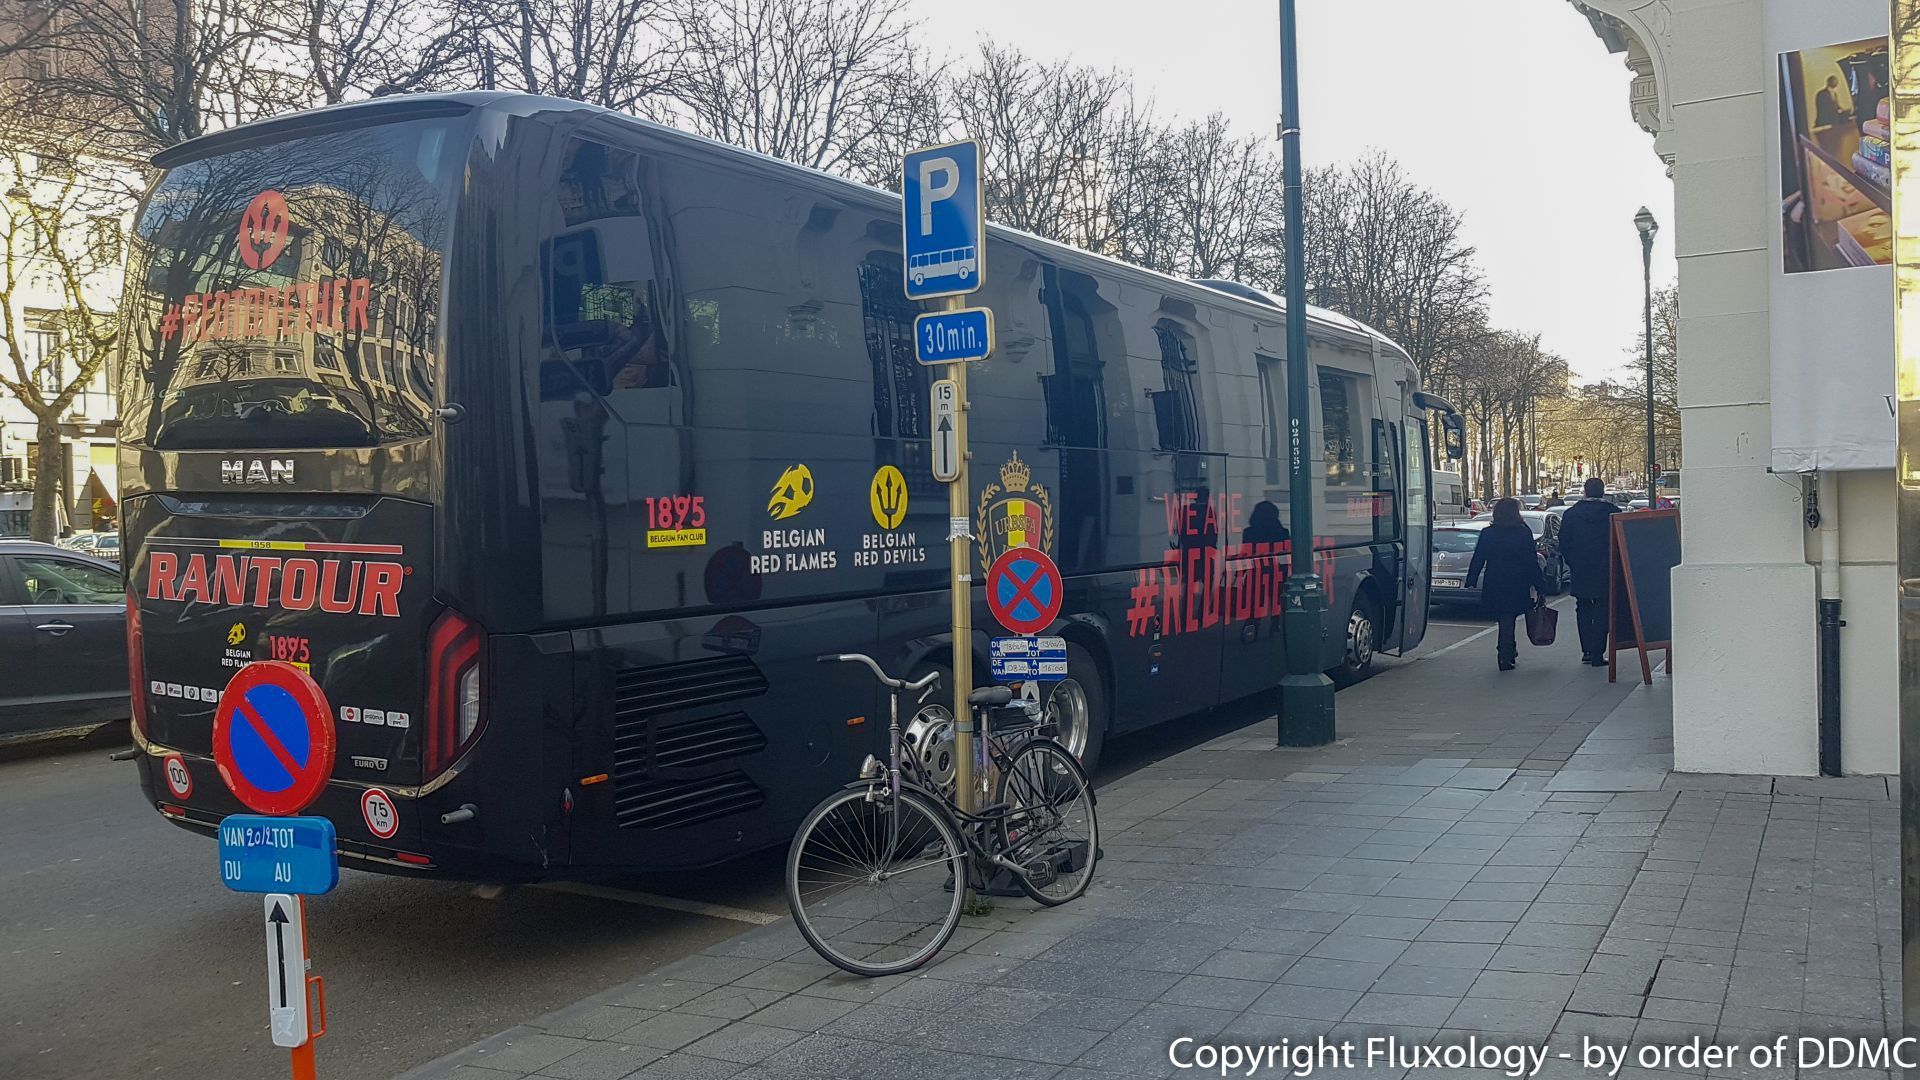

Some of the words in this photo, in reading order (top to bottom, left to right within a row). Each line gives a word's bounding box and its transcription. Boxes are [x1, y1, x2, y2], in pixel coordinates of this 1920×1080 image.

[919, 156, 960, 236] P
[160, 278, 370, 341] #REDTOGETHER
[938, 386, 951, 400] 15
[940, 403, 949, 411] m
[221, 459, 296, 484] MAN
[646, 494, 706, 533] 1895
[1164, 493, 1198, 535] WE
[1203, 493, 1243, 535] ARE
[251, 541, 271, 549] 1958
[650, 535, 676, 543] BELGIUM
[690, 533, 704, 541] CLUB
[763, 528, 825, 549] BELGIAN
[863, 532, 916, 549] BELGIAN
[751, 554, 781, 574] RED
[786, 551, 837, 572] FLAMES
[854, 551, 879, 567] RED
[883, 547, 926, 564] DEVILS
[147, 552, 404, 617] RANTOUR
[225, 648, 251, 658] BELGIAN
[269, 634, 310, 663] 1895
[221, 658, 233, 667] RED
[992, 668, 1007, 676] VAN
[354, 760, 375, 769] EURO
[169, 766, 188, 785] 100
[369, 801, 388, 818] 75
[375, 818, 388, 828] km
[223, 826, 245, 847] VAN
[271, 827, 294, 849] TOT
[225, 860, 241, 880] DU
[274, 862, 291, 882] AU
